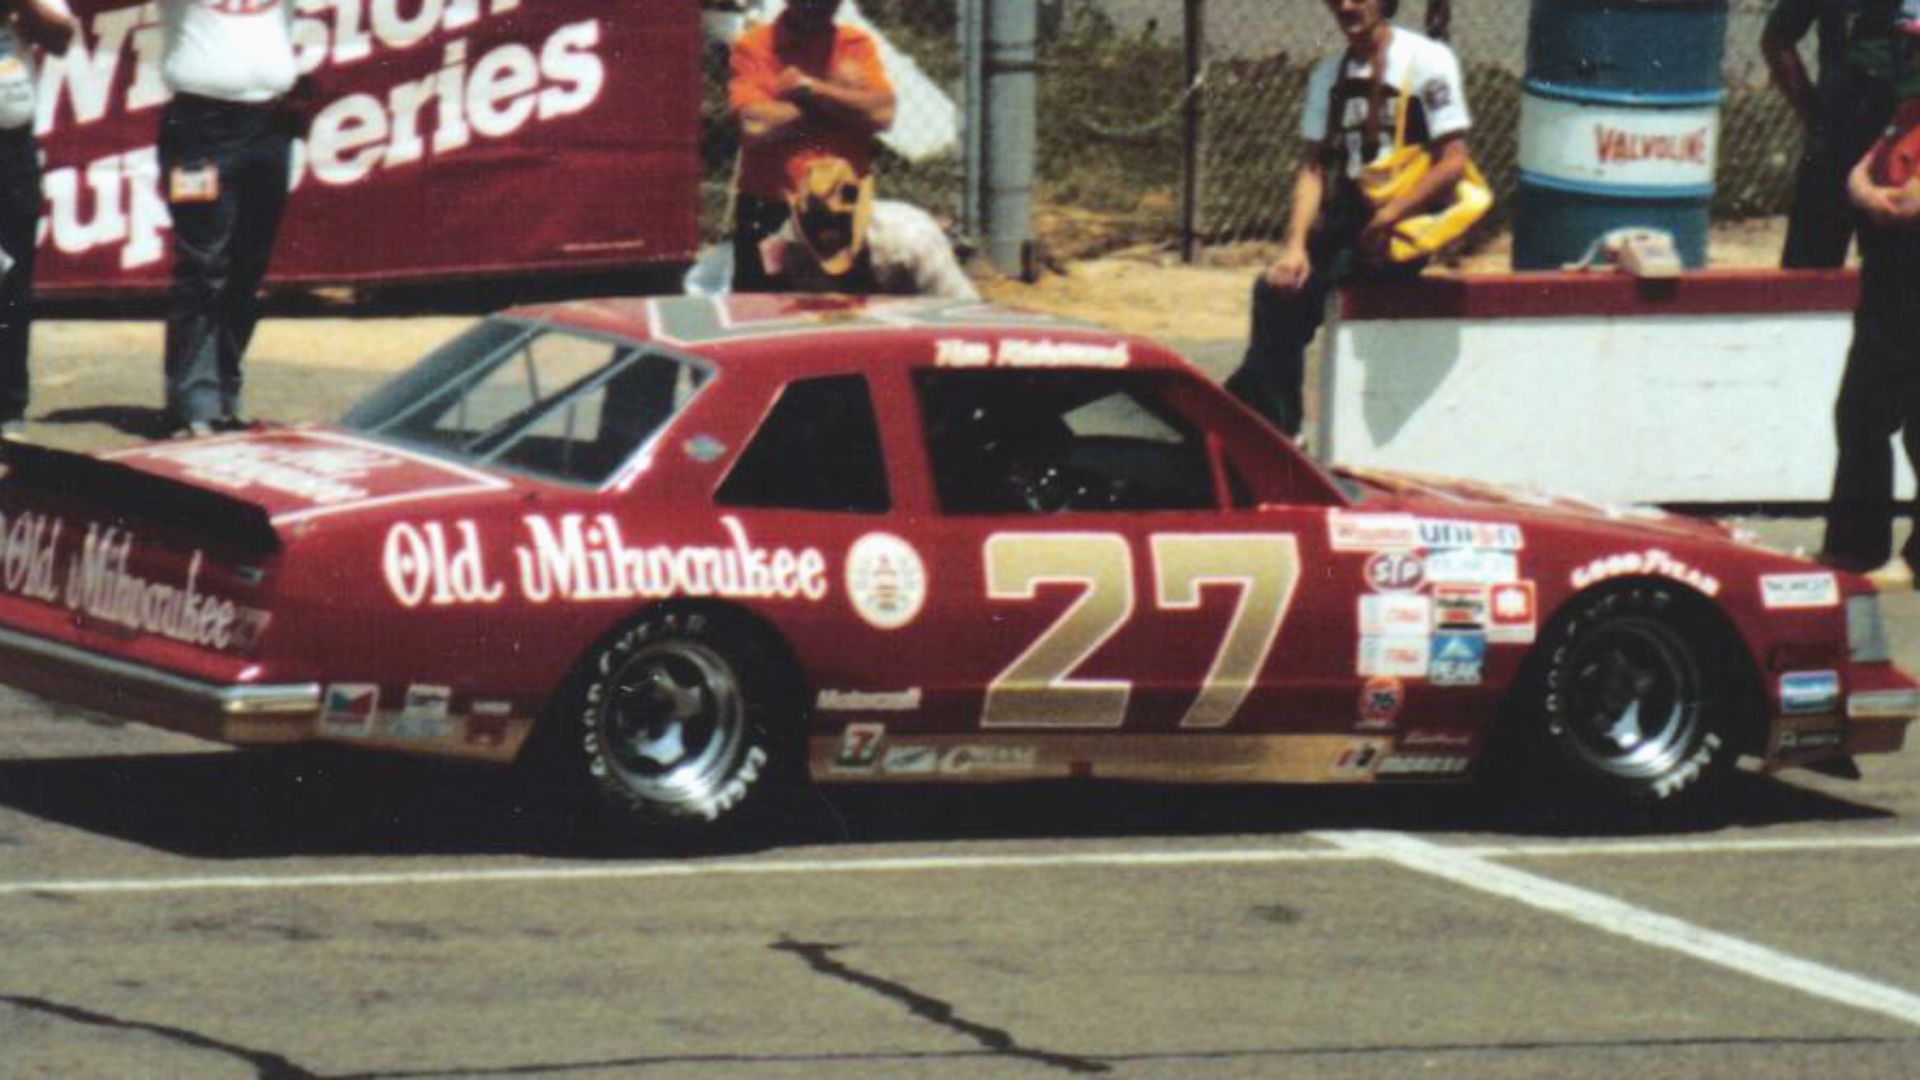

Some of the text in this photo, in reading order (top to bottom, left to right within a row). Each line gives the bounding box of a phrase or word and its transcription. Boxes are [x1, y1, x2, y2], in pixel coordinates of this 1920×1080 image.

[37, 20, 605, 270] up eries
[1594, 123, 1708, 167] VALVOLINE
[382, 520, 504, 607] Old
[515, 513, 828, 602] Milwaukee
[979, 531, 1301, 728] 27
